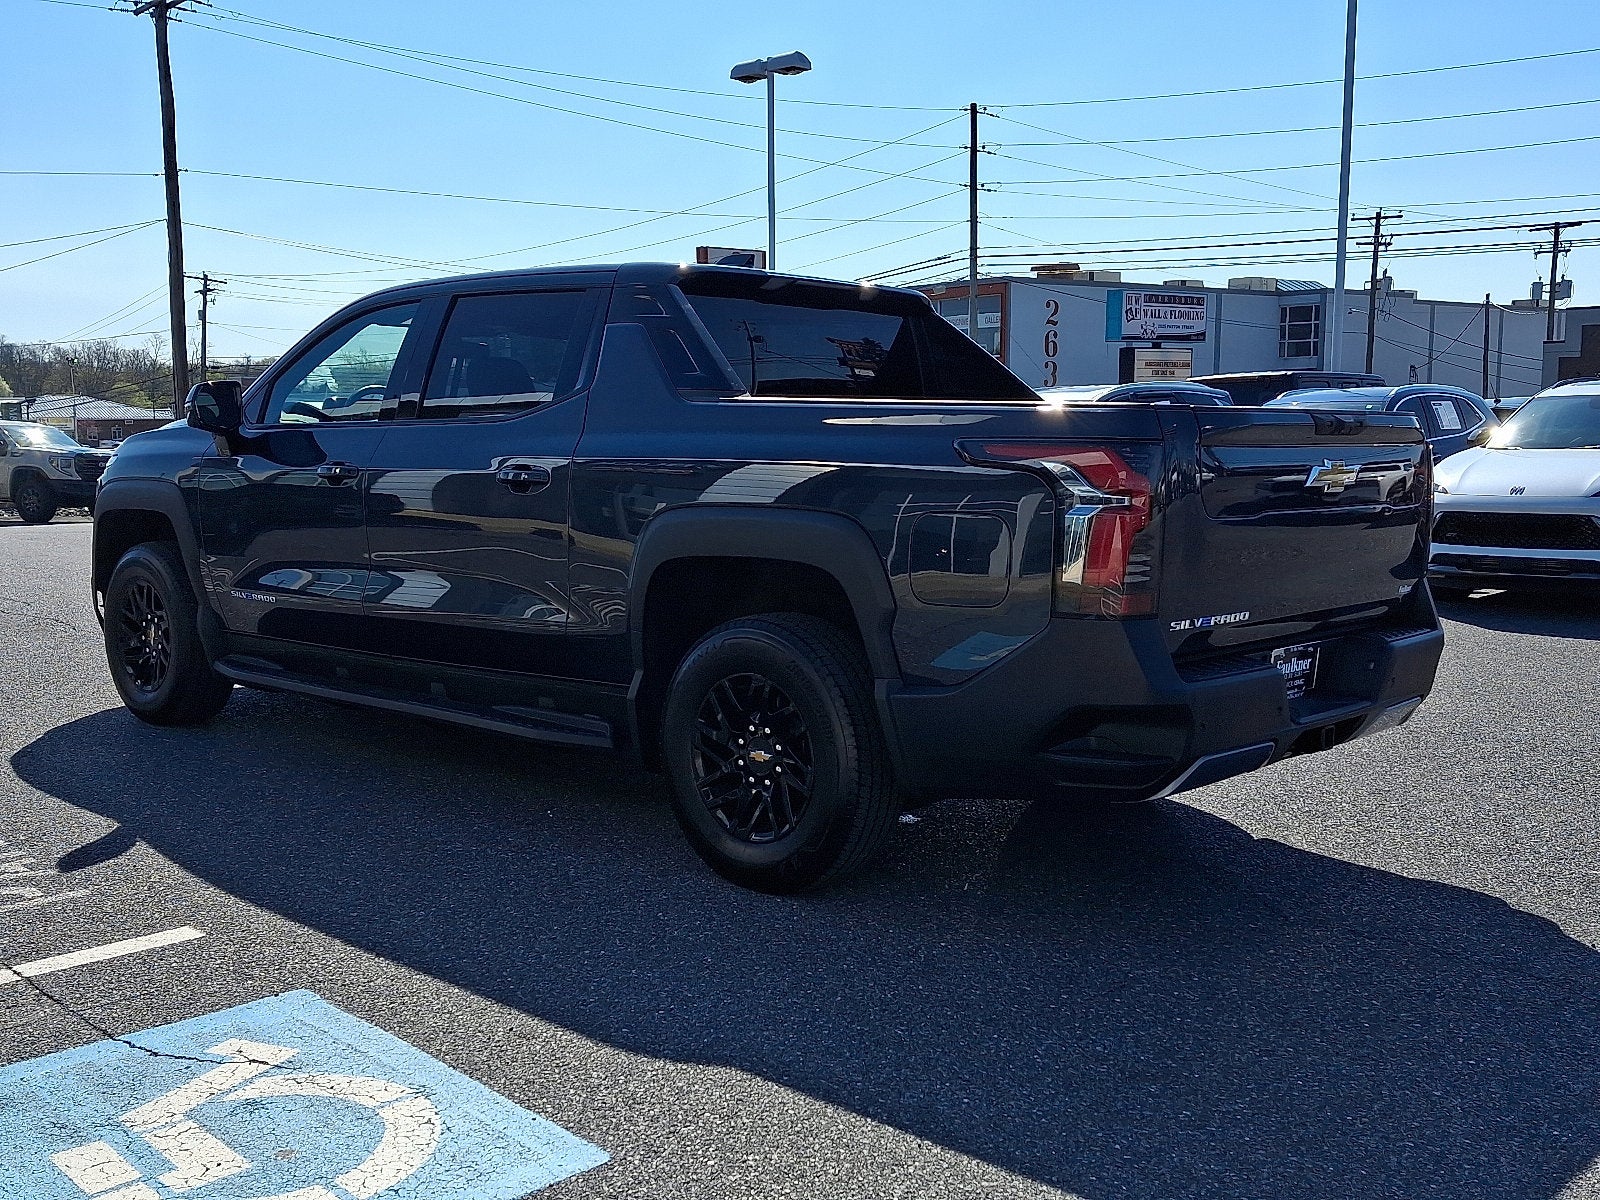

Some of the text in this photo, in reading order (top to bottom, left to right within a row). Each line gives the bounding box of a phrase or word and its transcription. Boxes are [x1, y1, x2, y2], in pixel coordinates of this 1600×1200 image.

[1144, 295, 1204, 305] HARRISBURG
[1142, 308, 1205, 320] WALL & FLOORING
[231, 590, 276, 603] SILVERADO
[1169, 611, 1250, 631] SILVERADO
[1276, 657, 1312, 674] Faulkner
